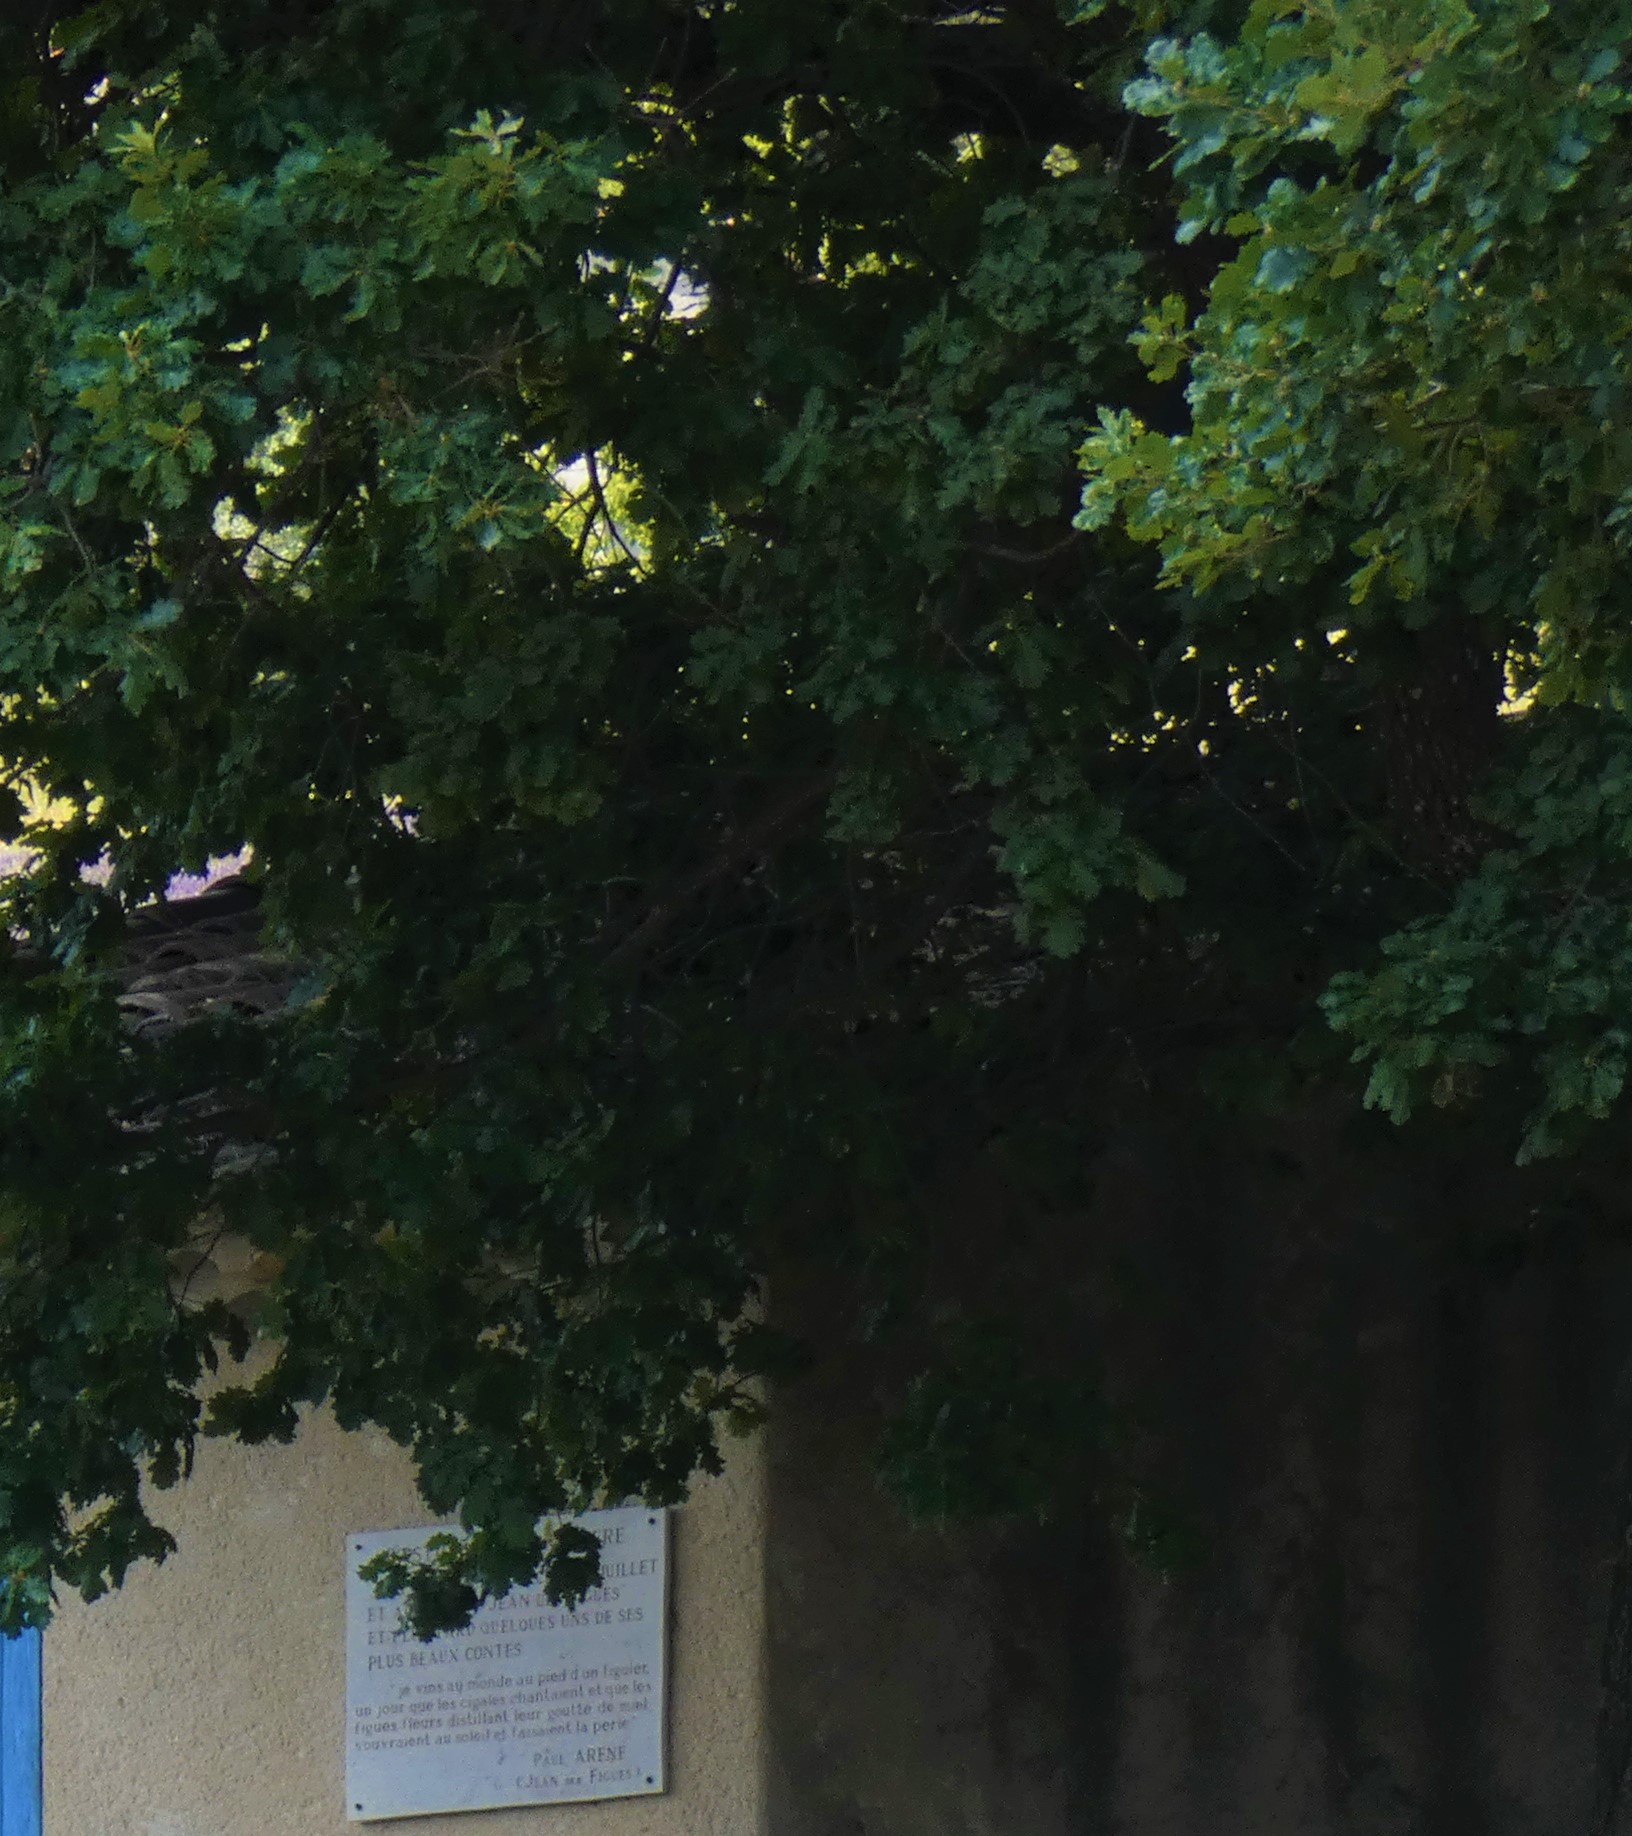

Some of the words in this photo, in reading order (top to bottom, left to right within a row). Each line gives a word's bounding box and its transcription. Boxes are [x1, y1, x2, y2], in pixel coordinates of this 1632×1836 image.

[368, 1631, 385, 1645] ET
[479, 1616, 555, 1634] QUELQUES
[594, 1610, 612, 1625] DE
[618, 1607, 643, 1623] SES
[368, 1654, 404, 1671] PLUS
[410, 1648, 459, 1667] BEAUX
[464, 1642, 521, 1661] CONTES
[467, 1675, 513, 1690] monde
[516, 1675, 533, 1685] au
[538, 1668, 566, 1687] pied
[355, 1706, 371, 1717] un
[377, 1703, 404, 1719] jour
[409, 1701, 434, 1715] que
[437, 1698, 456, 1711] les
[509, 1684, 584, 1705] chantaient
[588, 1684, 601, 1698] et
[604, 1684, 629, 1699] que
[632, 1679, 651, 1694] les
[354, 1721, 397, 1737] figues
[514, 1708, 540, 1722] leur
[547, 1703, 592, 1721] goutte
[597, 1702, 614, 1714] de
[434, 1734, 451, 1745] au
[576, 1720, 588, 1733] la
